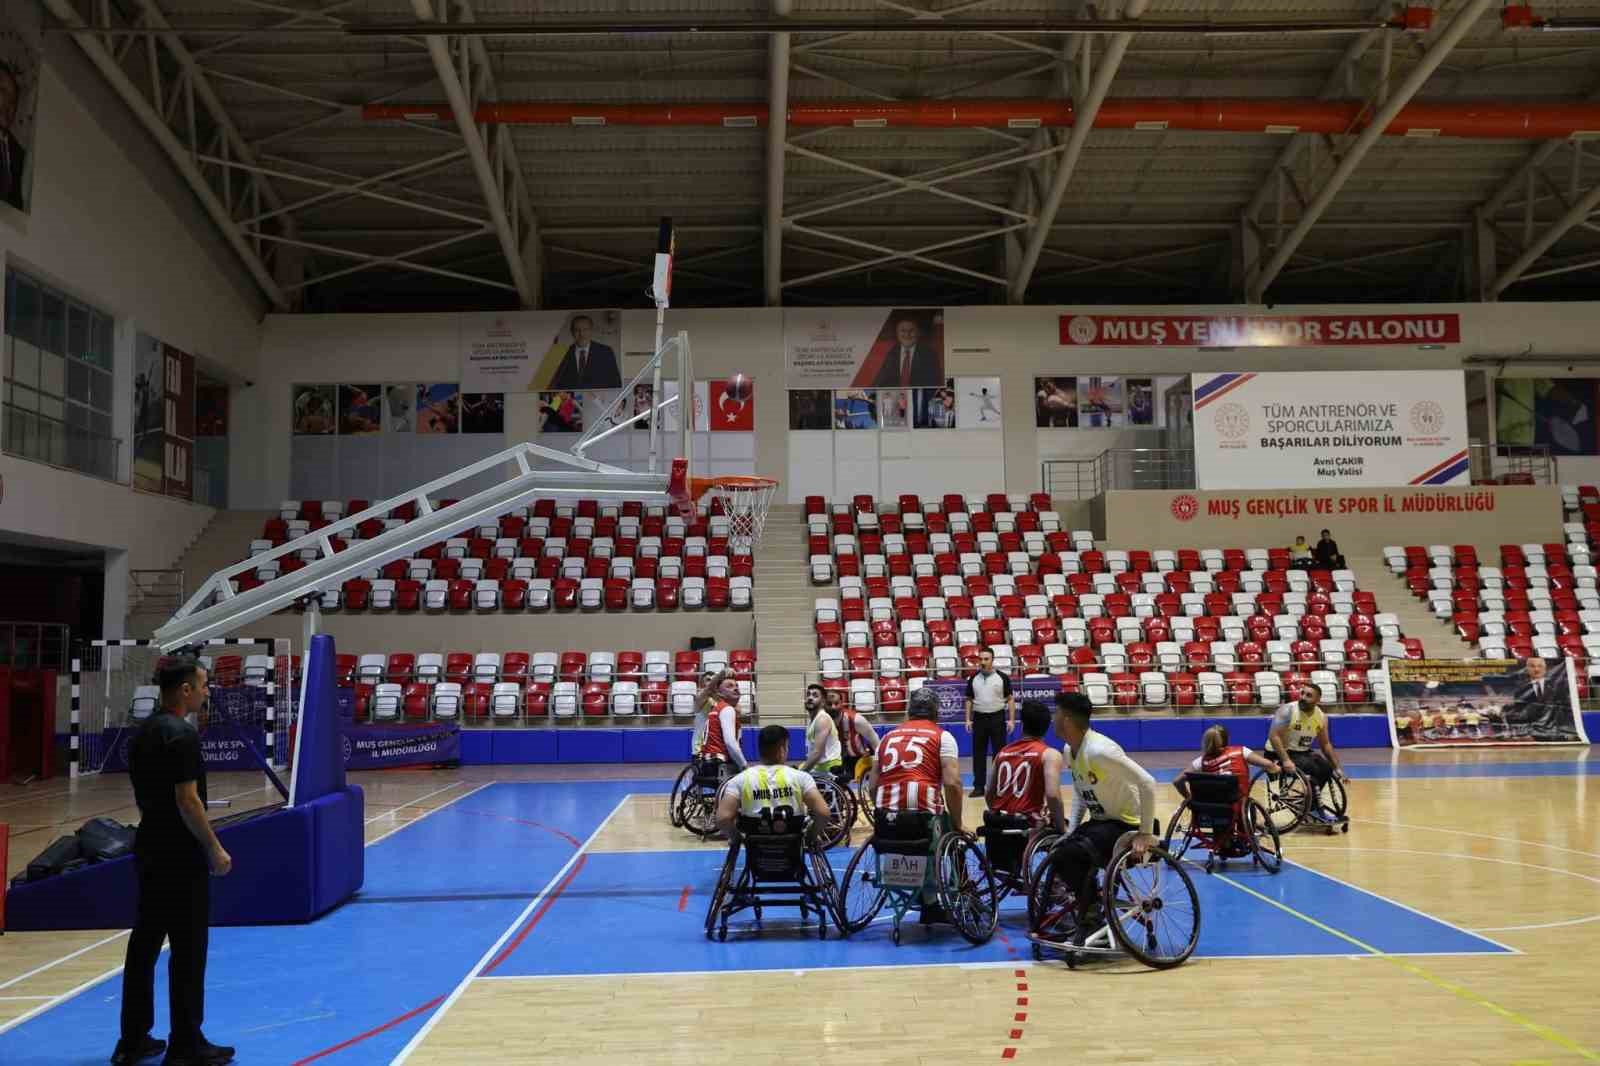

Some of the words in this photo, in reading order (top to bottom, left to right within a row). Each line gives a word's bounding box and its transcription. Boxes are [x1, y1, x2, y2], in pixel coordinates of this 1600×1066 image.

[1103, 321, 1167, 344] MUŞ
[1329, 319, 1446, 340] SALONU
[1263, 403, 1295, 418] TÜM
[1299, 402, 1377, 418] ANTRENÖR
[1380, 403, 1398, 417] VE
[1267, 419, 1394, 433] SPORCULARIMIZA
[1260, 437, 1330, 450] BAŞARILAR
[1333, 434, 1402, 447] DİLİYORUM
[1208, 499, 1241, 519] MUŞ
[1246, 496, 1308, 518] GENÇLİK
[1315, 498, 1333, 513] VE
[1339, 497, 1378, 513] SPOR
[1384, 494, 1396, 513] İL
[1402, 492, 1495, 512] MÜDÜRLÜĞÜ
[882, 736, 930, 773] 55
[996, 761, 1031, 798] 00
